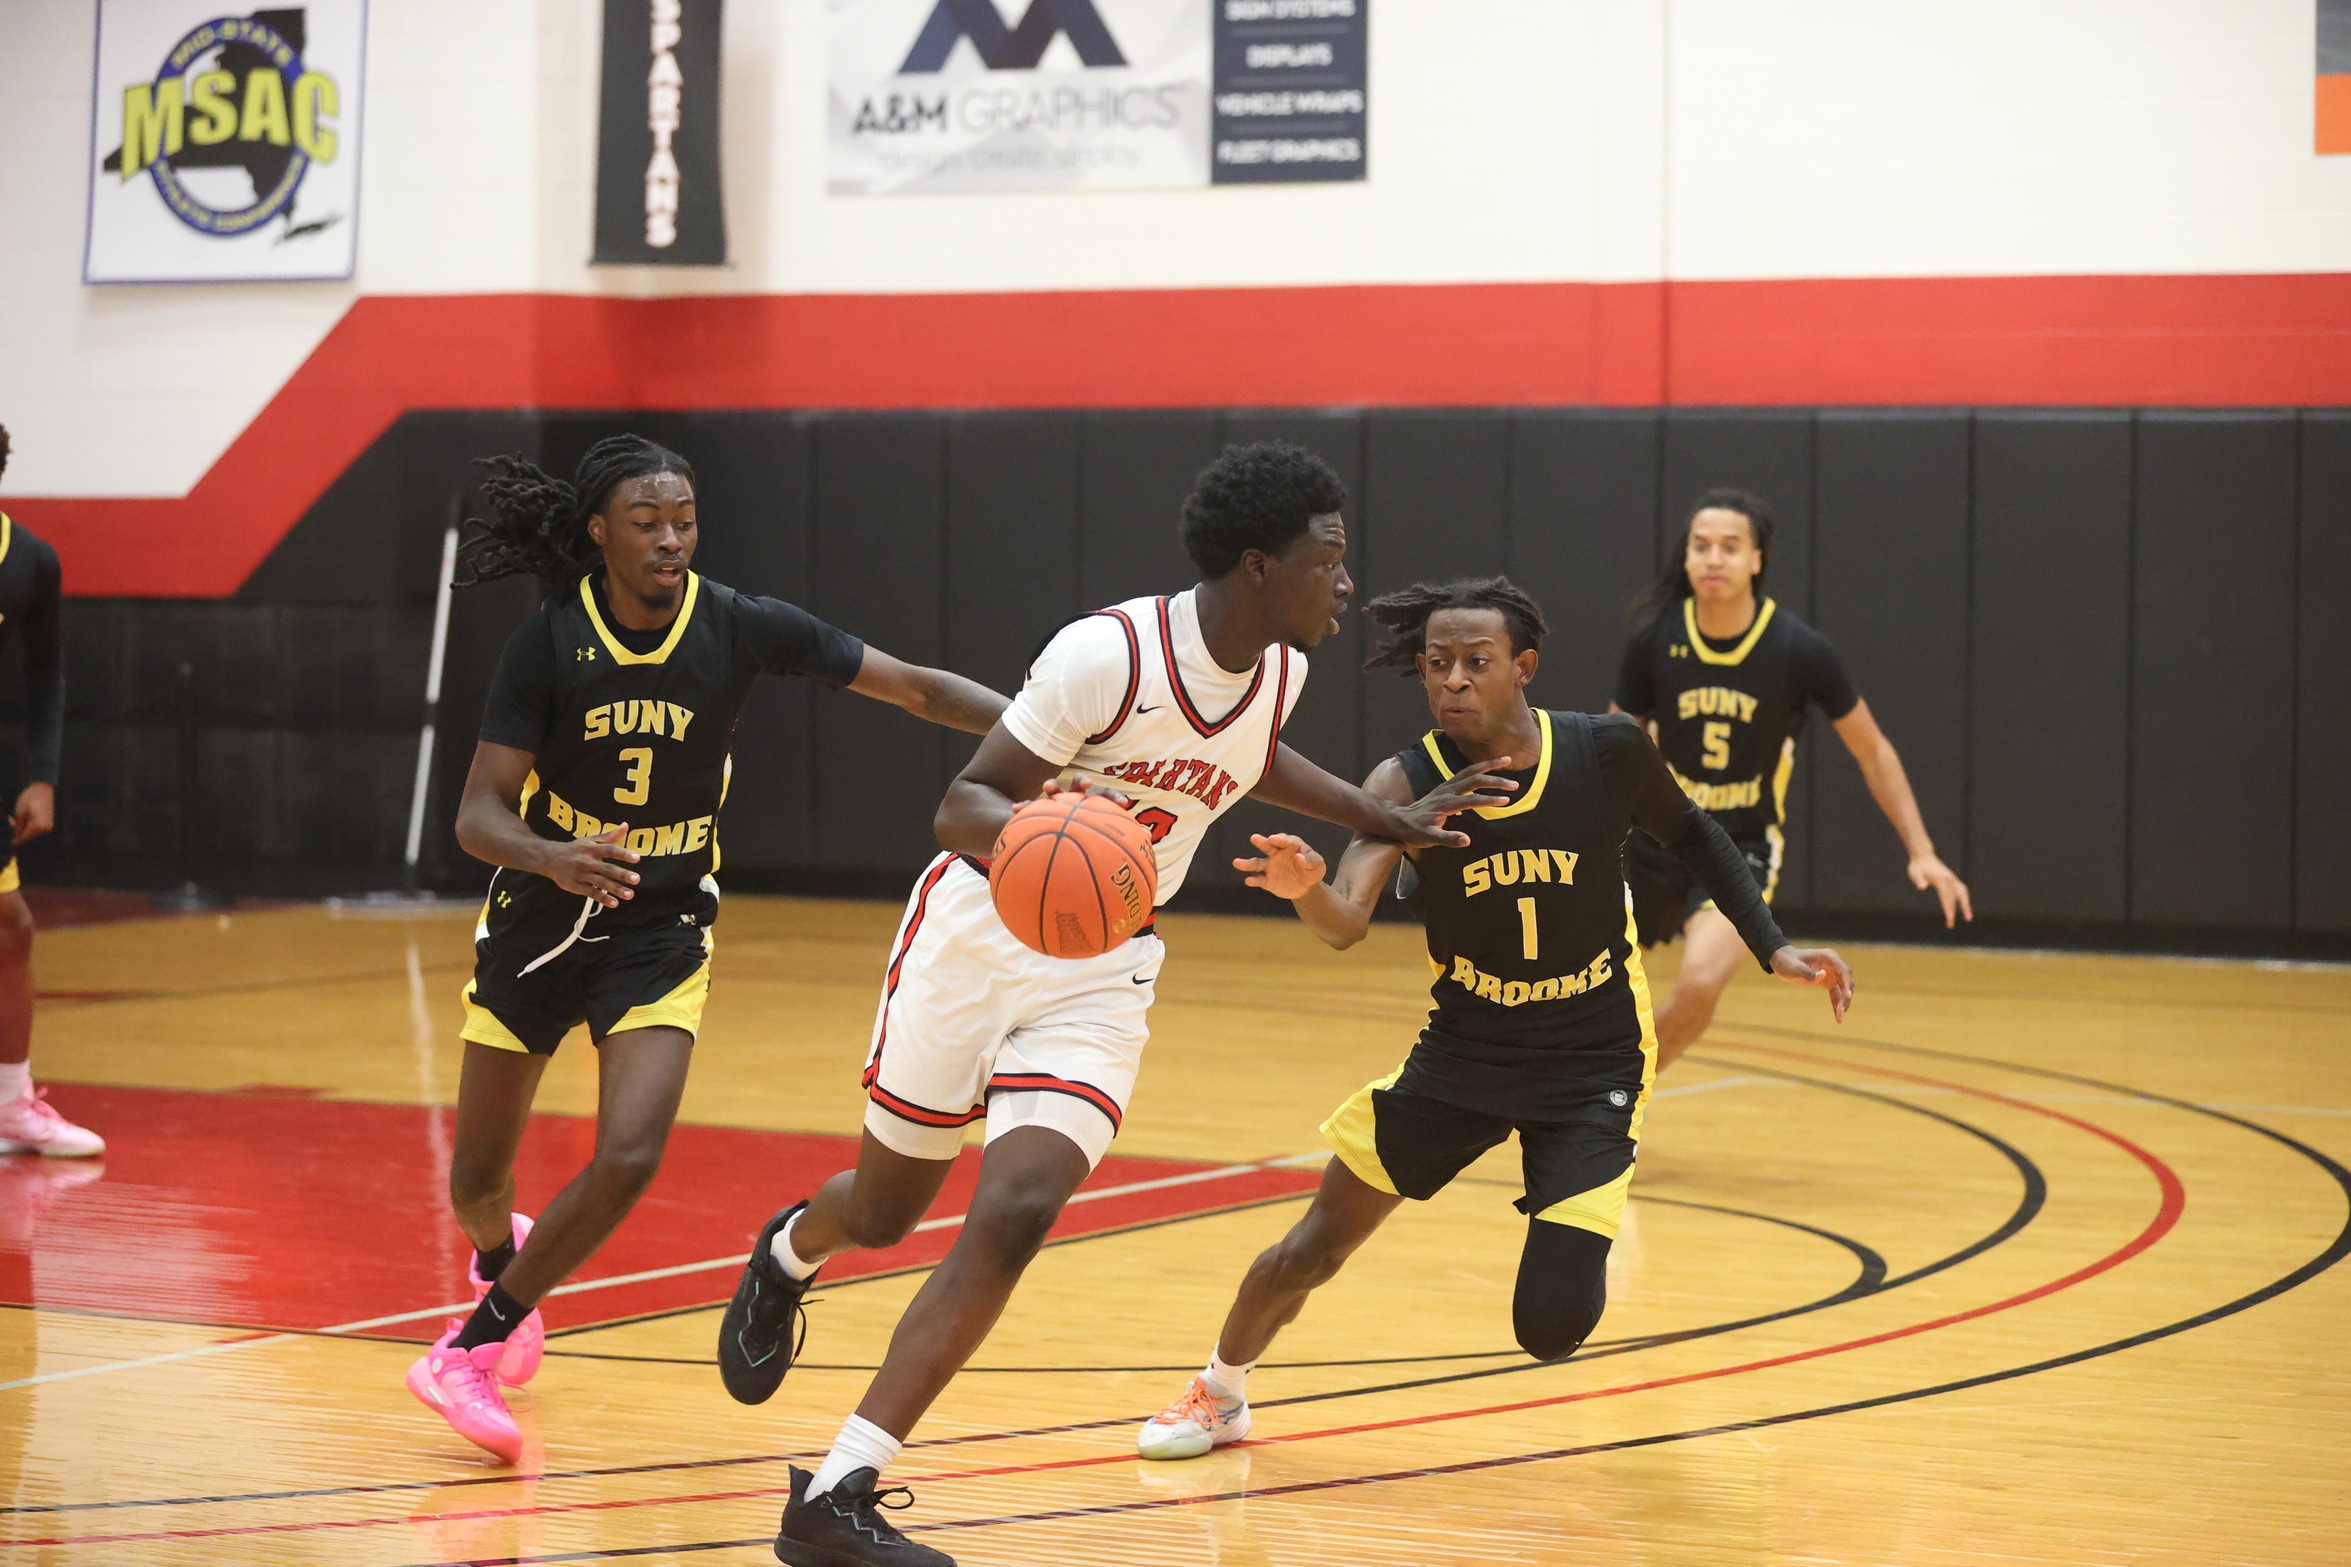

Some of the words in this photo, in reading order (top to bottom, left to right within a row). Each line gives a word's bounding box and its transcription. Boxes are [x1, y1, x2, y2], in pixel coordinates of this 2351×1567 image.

[1246, 43, 1332, 68] DISPLAYS
[121, 67, 339, 182] MSAC
[854, 95, 949, 134] A&M
[955, 84, 1182, 134] GRAPHICS
[1216, 92, 1293, 116] VEHICLE
[1295, 90, 1363, 113] WRAPS
[1217, 140, 1268, 164] FLEET
[1270, 138, 1360, 163] GRAPHICS
[584, 699, 695, 742] SUNY
[1678, 686, 1758, 724] SUNY
[1702, 721, 1731, 770] 5
[614, 747, 653, 806] 3
[1462, 849, 1580, 898] SUNY
[1517, 896, 1538, 960] 1
[1450, 947, 1613, 1007] BROOME
